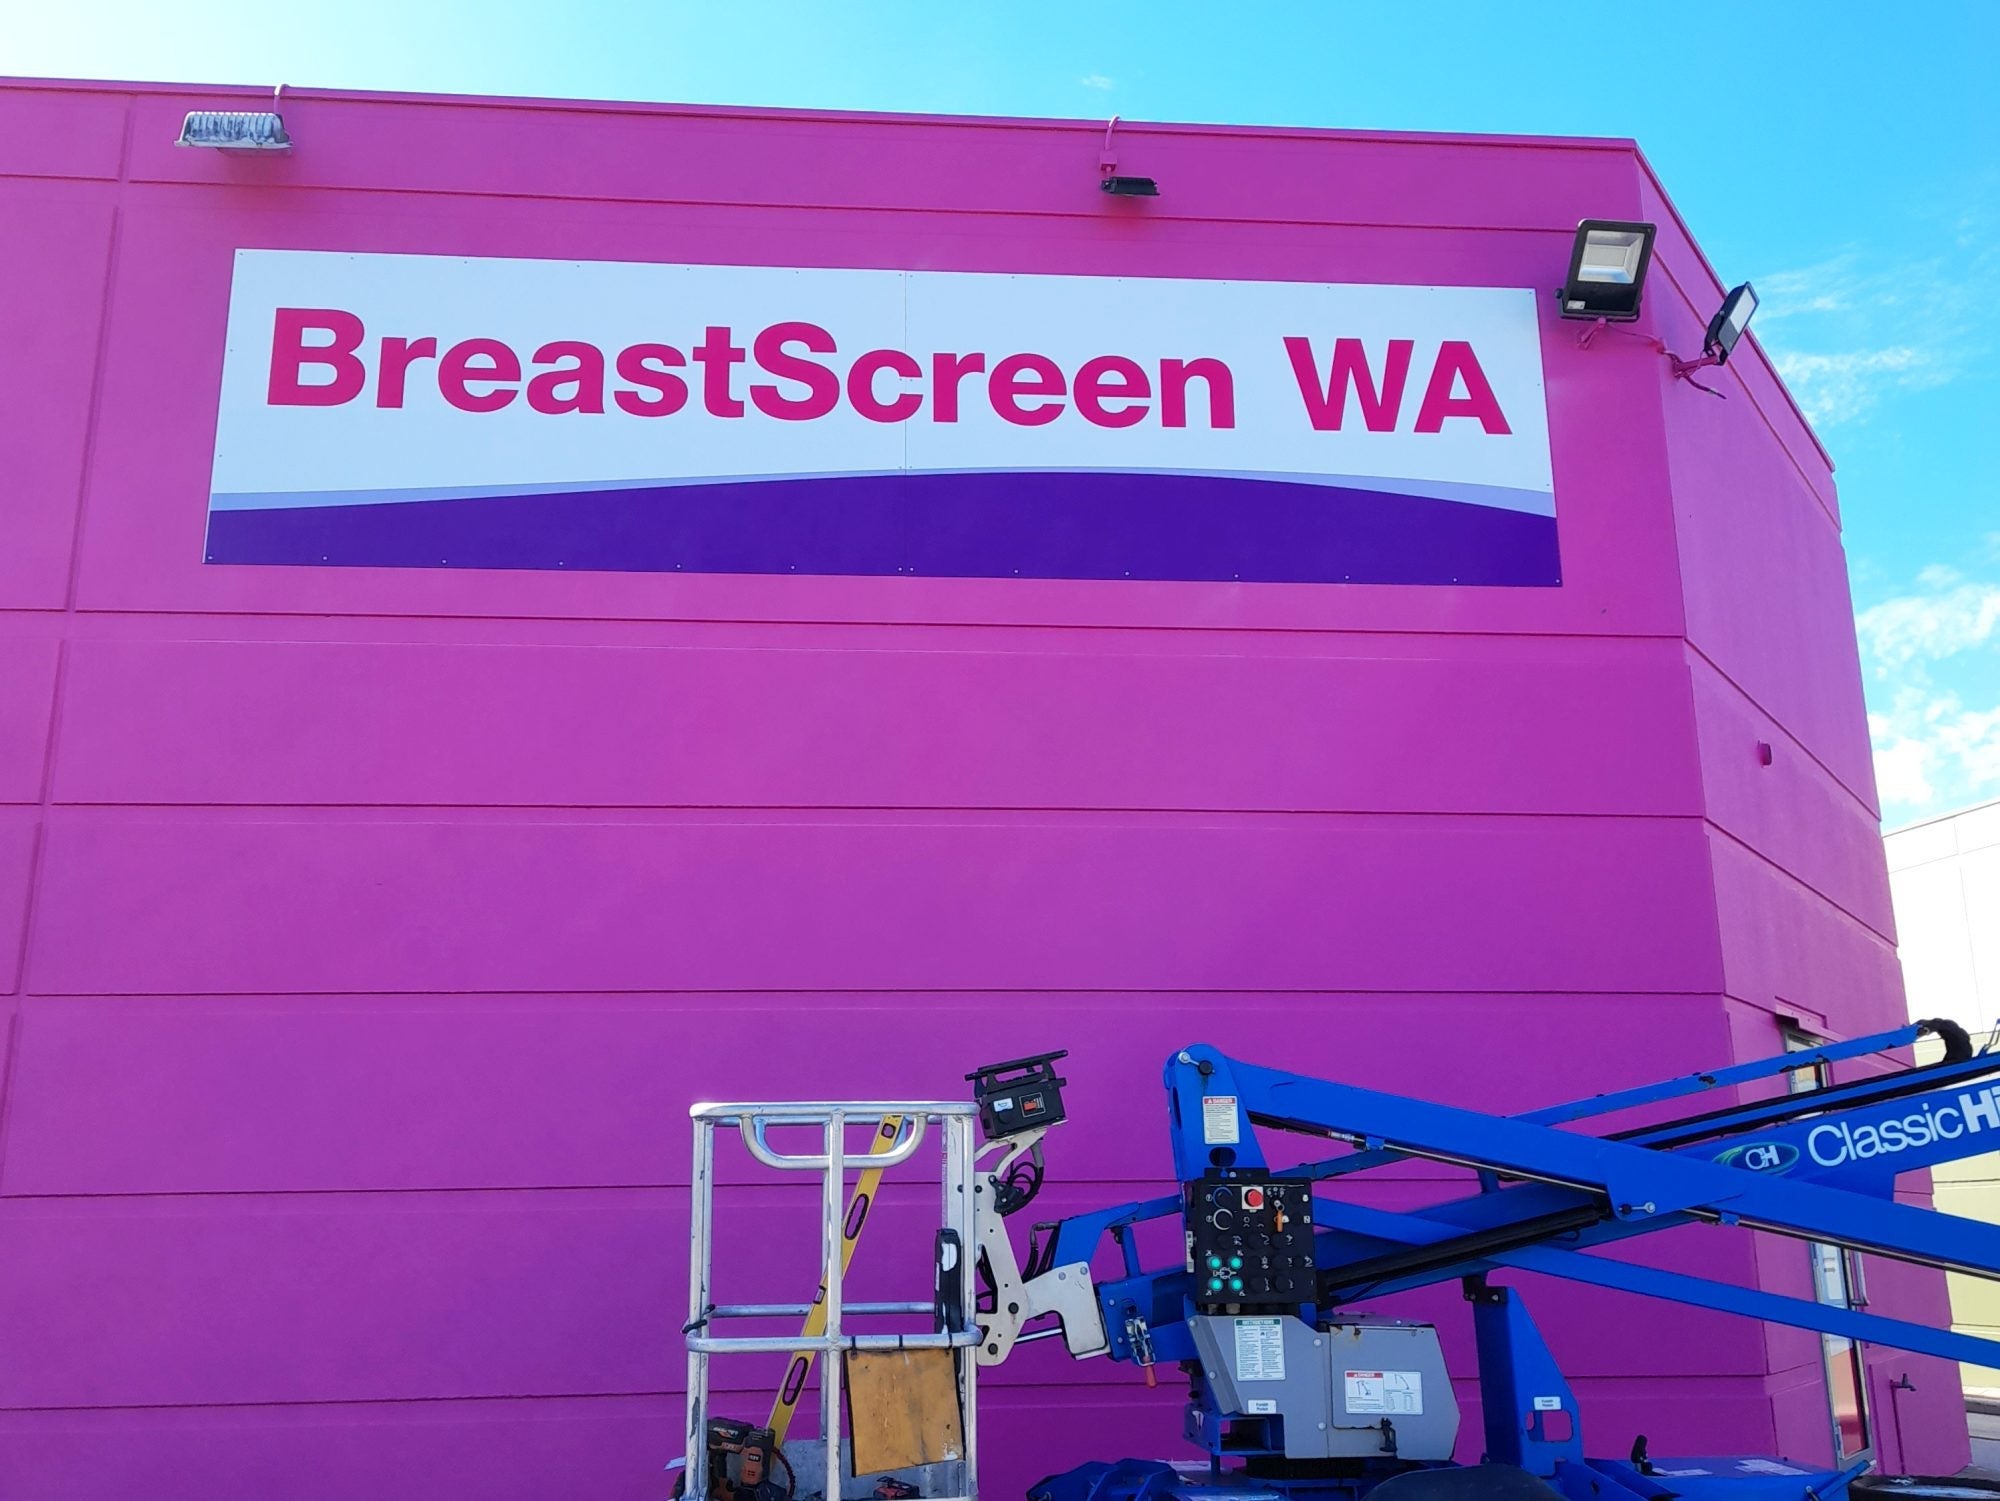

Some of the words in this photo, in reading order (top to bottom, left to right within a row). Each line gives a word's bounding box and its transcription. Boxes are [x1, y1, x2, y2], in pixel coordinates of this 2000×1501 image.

[267, 307, 1235, 429] BreastScreen
[1282, 336, 1513, 436] WA
[1745, 1144, 1780, 1170] CH
